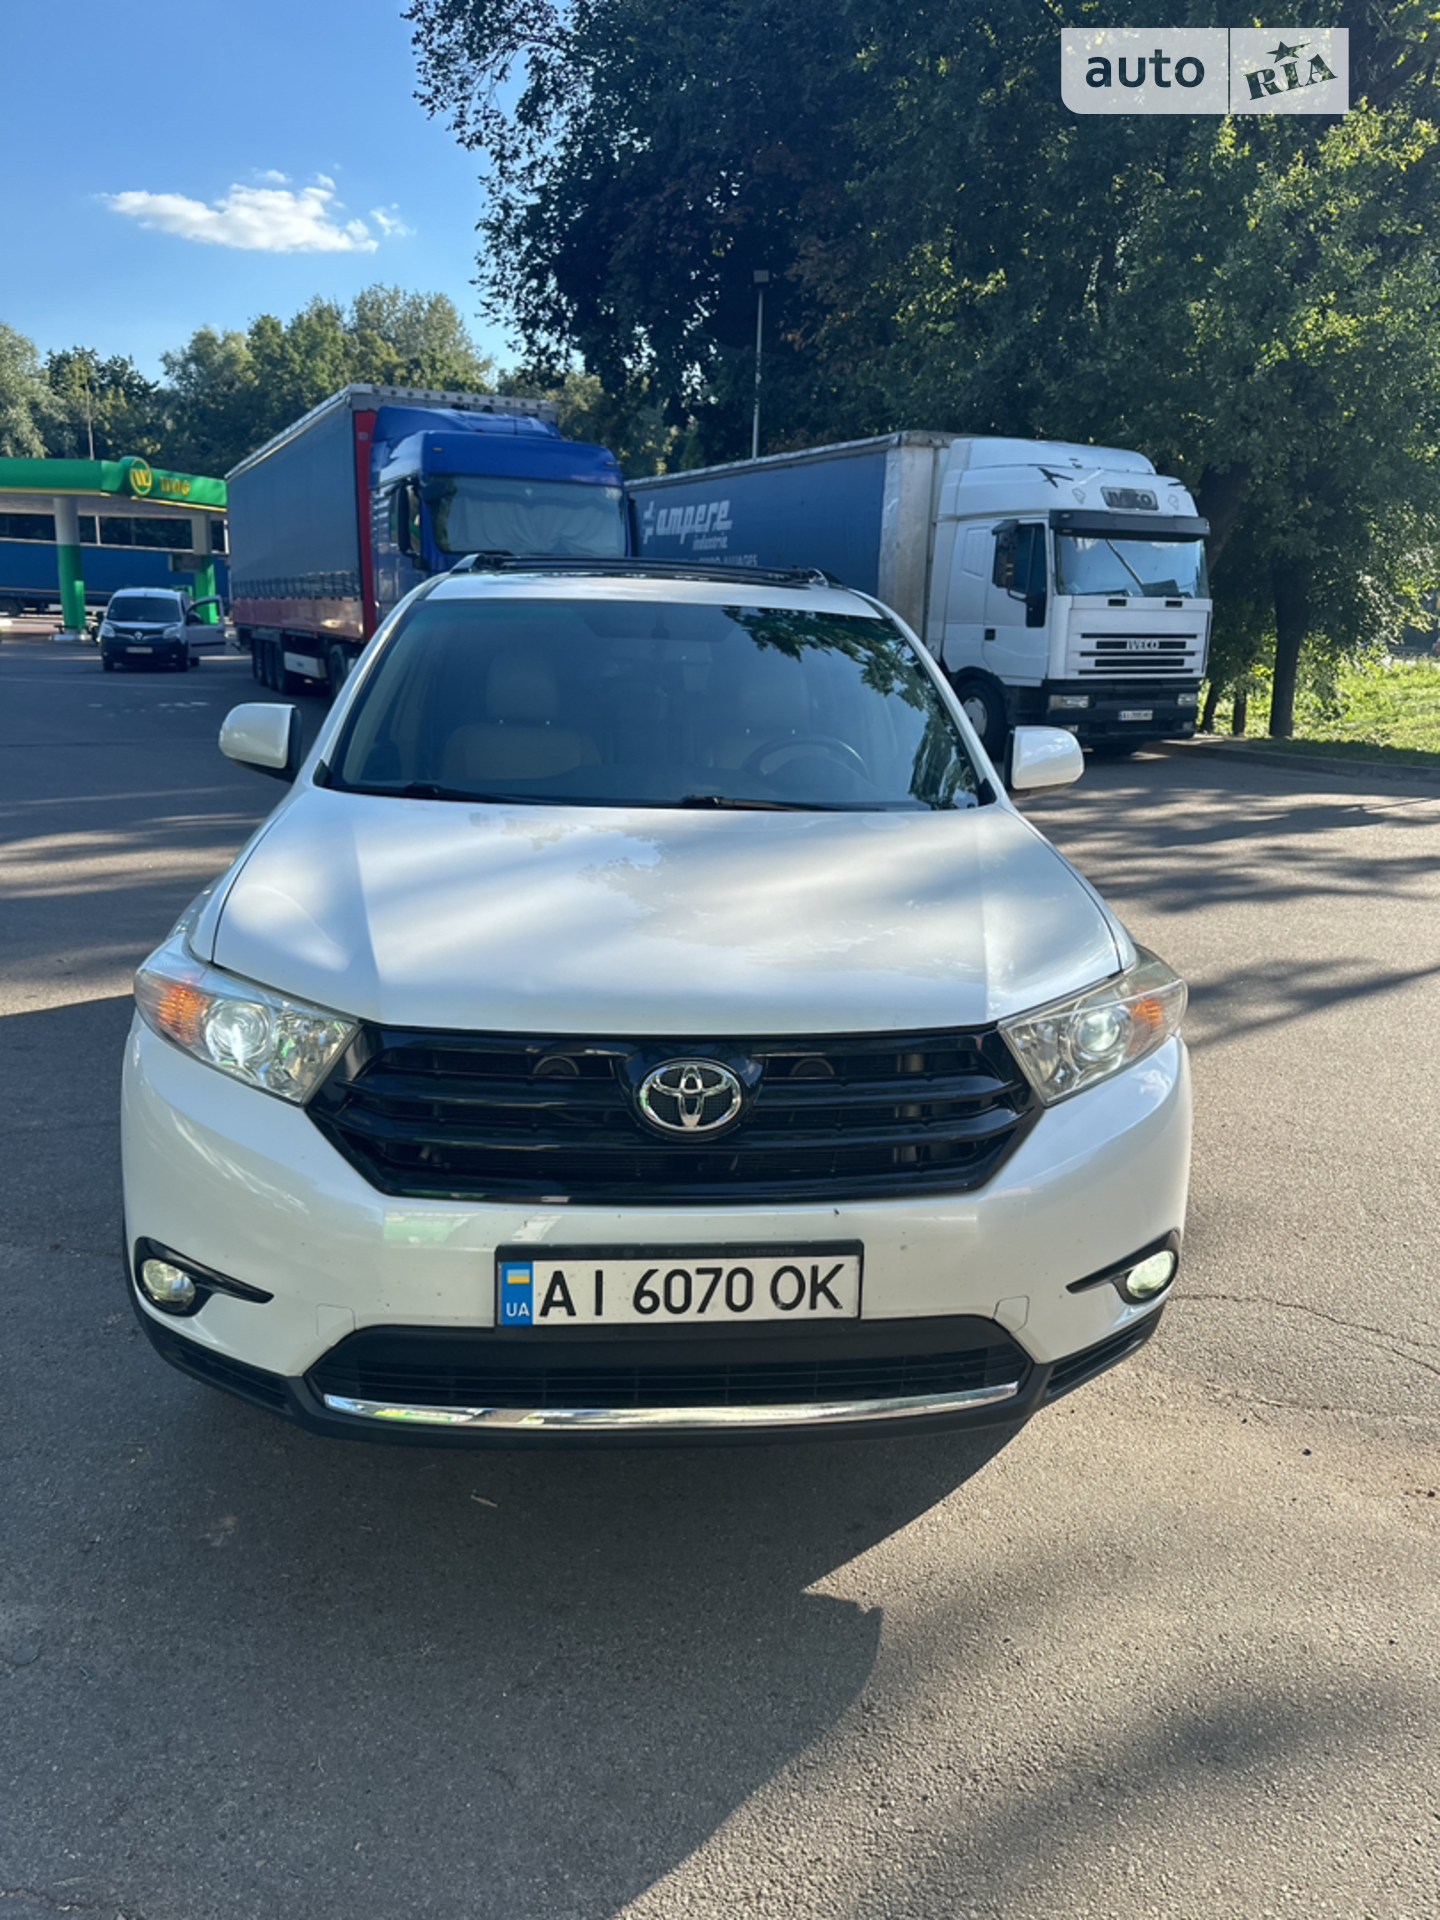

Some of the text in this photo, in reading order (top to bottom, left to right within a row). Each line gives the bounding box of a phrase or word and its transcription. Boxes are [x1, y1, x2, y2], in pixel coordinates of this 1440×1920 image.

[1126, 640, 1160, 650] IVECO
[539, 1263, 845, 1317] AI 6070 OK
[506, 1303, 530, 1317] UA
